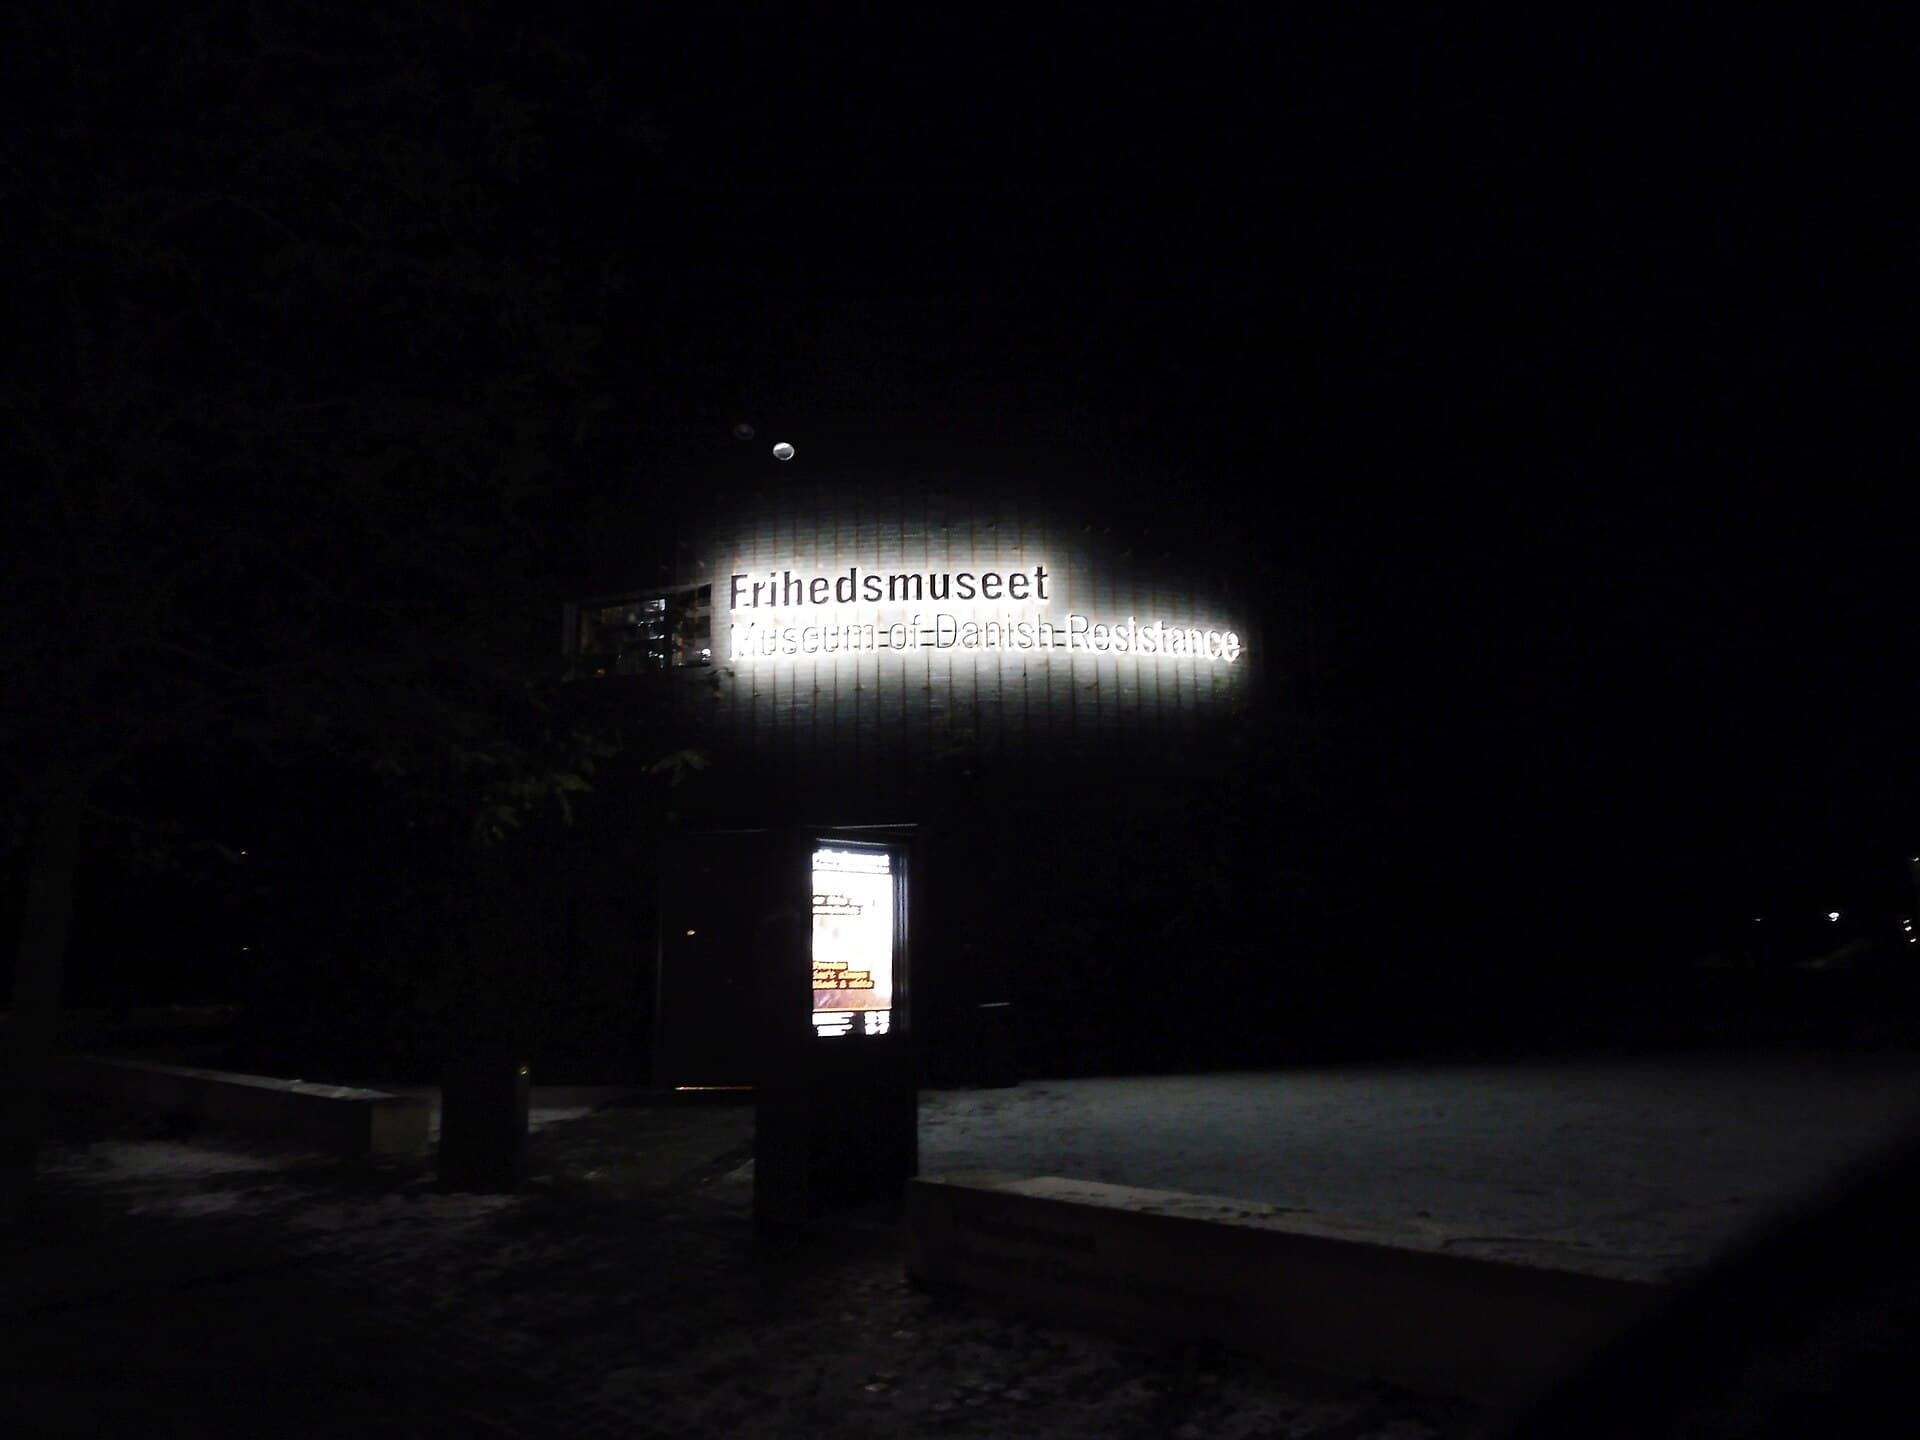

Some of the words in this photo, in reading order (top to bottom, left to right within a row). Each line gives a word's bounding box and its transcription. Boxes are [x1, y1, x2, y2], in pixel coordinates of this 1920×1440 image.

[729, 566, 1049, 609] Frihedsmuseet
[730, 622, 874, 660] Museum
[889, 614, 921, 650] of
[936, 612, 1055, 650] Danish
[1067, 613, 1241, 661] Resistance
